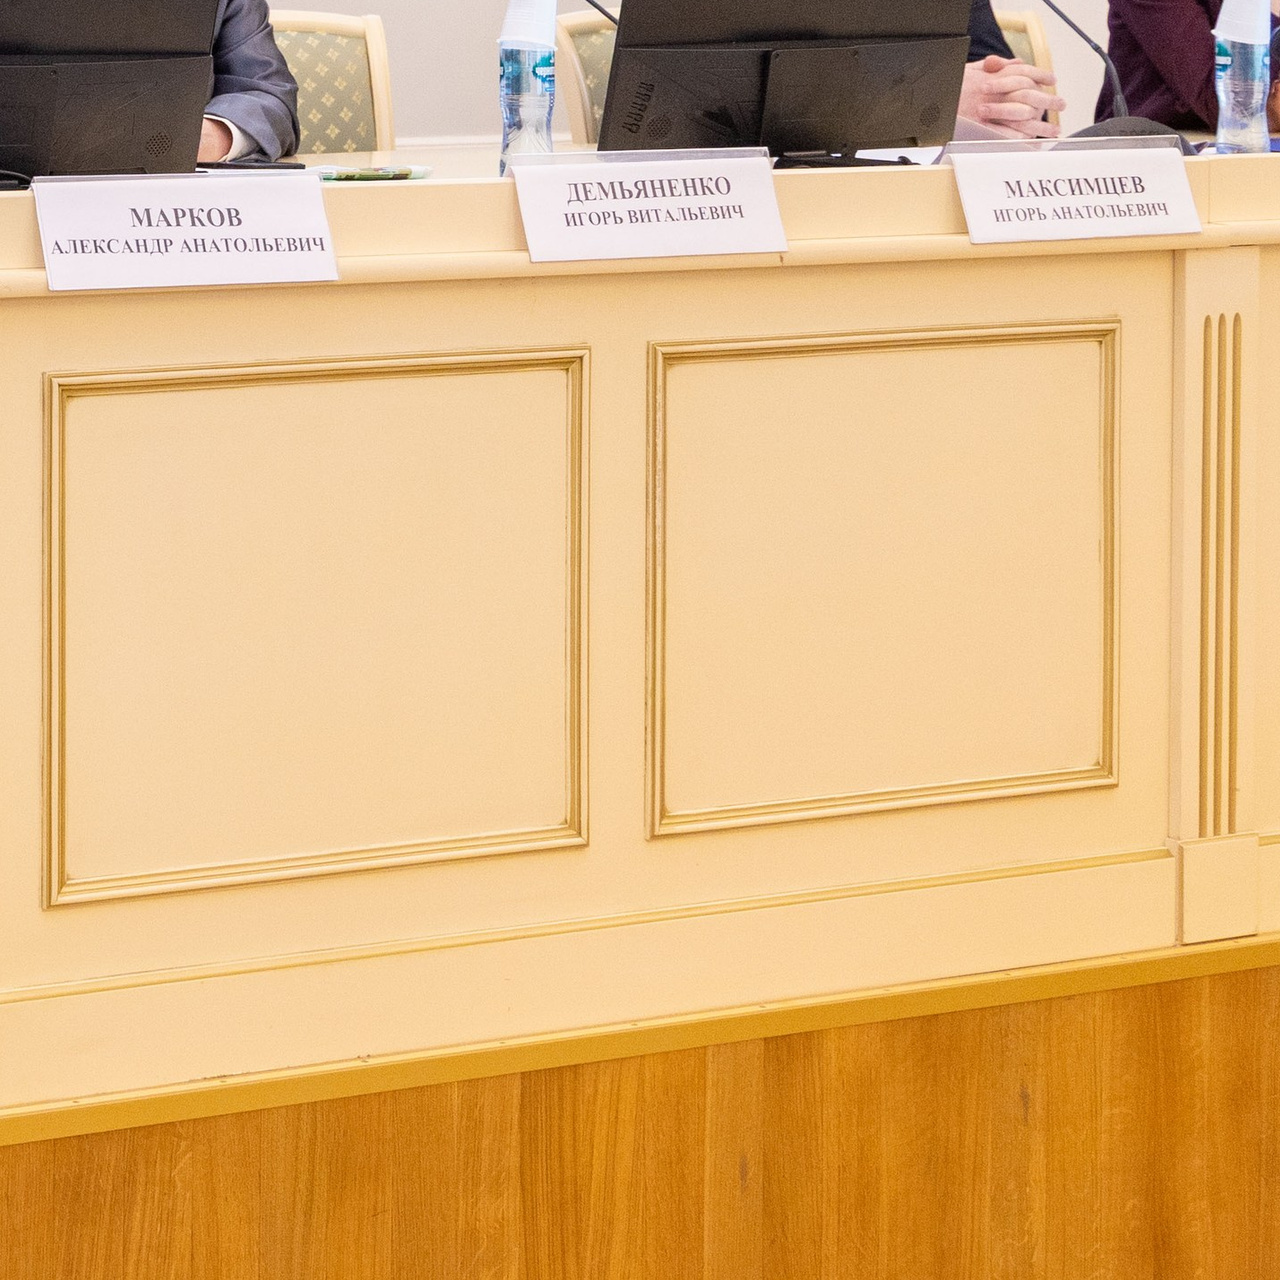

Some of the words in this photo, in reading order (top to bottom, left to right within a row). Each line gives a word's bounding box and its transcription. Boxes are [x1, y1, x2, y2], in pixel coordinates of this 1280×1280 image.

[567, 176, 731, 205] ДЕМЬЯНЕНКО
[1004, 176, 1146, 199] МАКСИМЦЕВ
[129, 207, 243, 228] МАРКОВ
[564, 210, 623, 227] ИГОРЬ
[627, 205, 745, 224] ВИТАЛЬЕВИЧ
[993, 206, 1046, 222] ИГОРЬ
[1052, 202, 1169, 220] АНАТОЛЬЕВИЧ
[51, 238, 173, 255] АЛЕКСАНДР
[180, 236, 326, 253] АНАТОЛЬЕВИЧ
